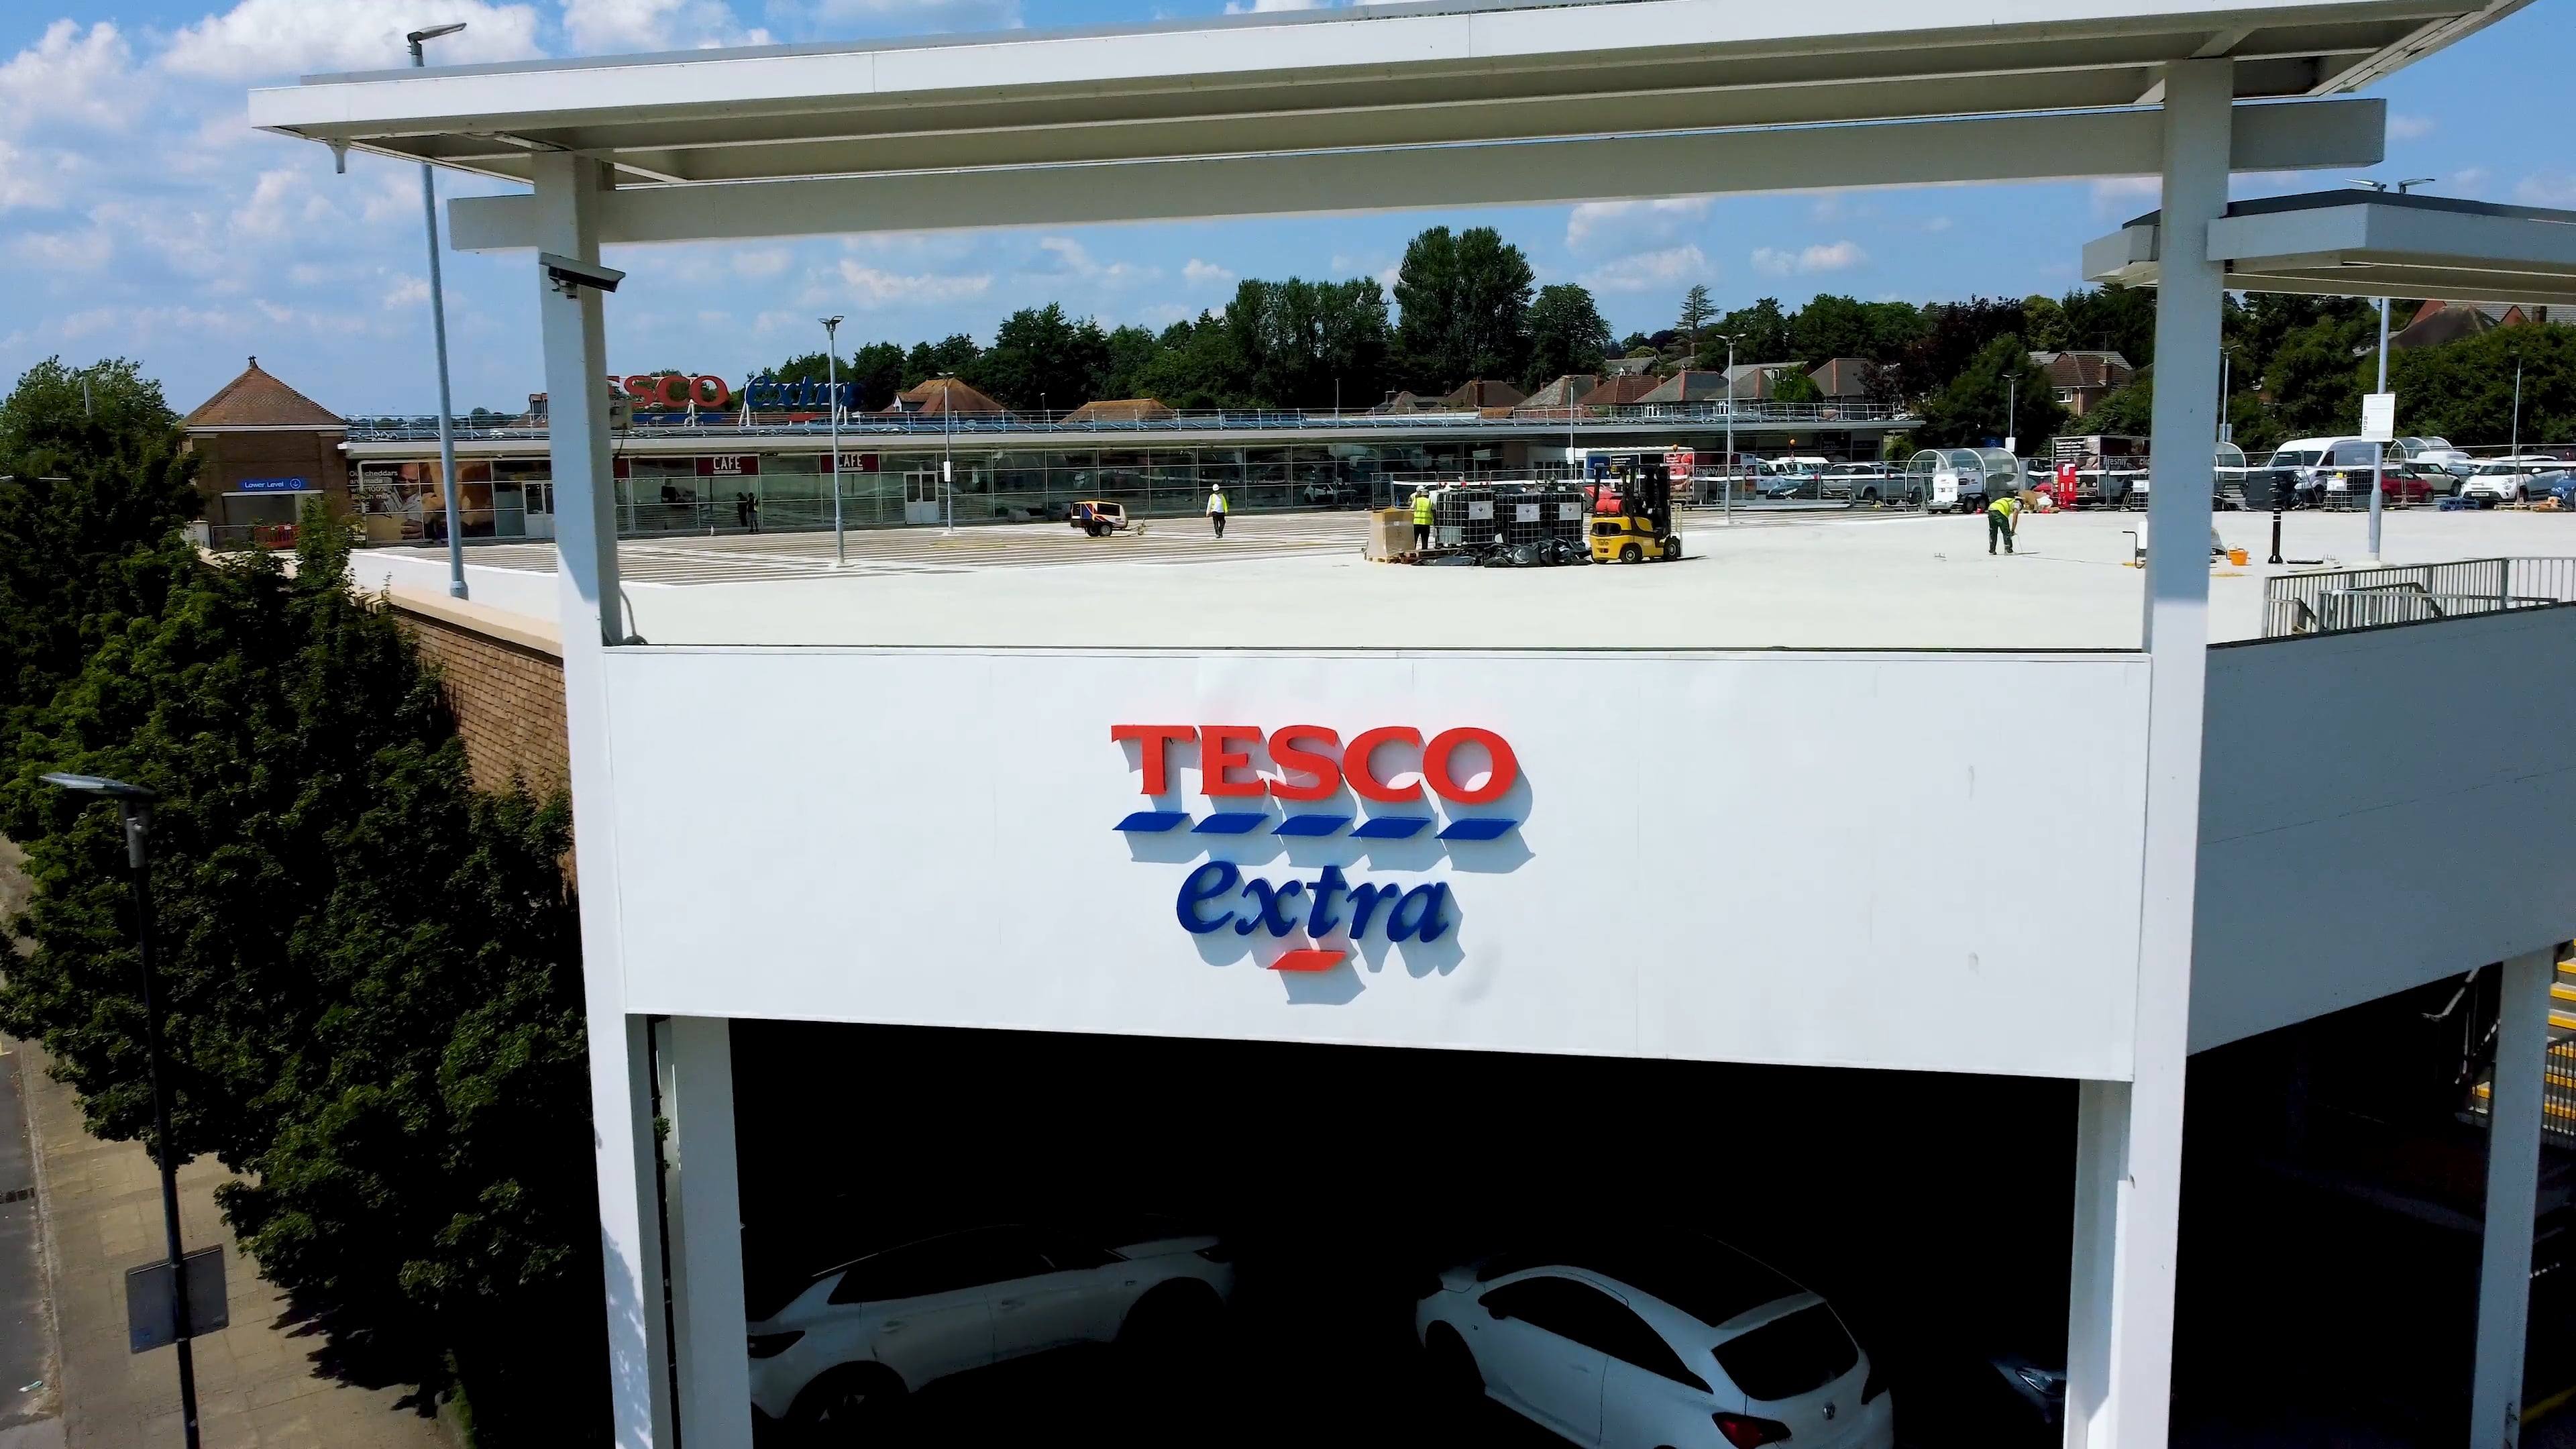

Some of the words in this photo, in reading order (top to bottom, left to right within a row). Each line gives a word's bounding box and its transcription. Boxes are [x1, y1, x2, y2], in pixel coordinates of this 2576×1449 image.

[606, 375, 730, 407] SCO
[713, 456, 741, 470] CAFE
[1695, 466, 1719, 476] Freshly
[1111, 724, 1518, 804] TESCO
[1176, 860, 1450, 943] extra
